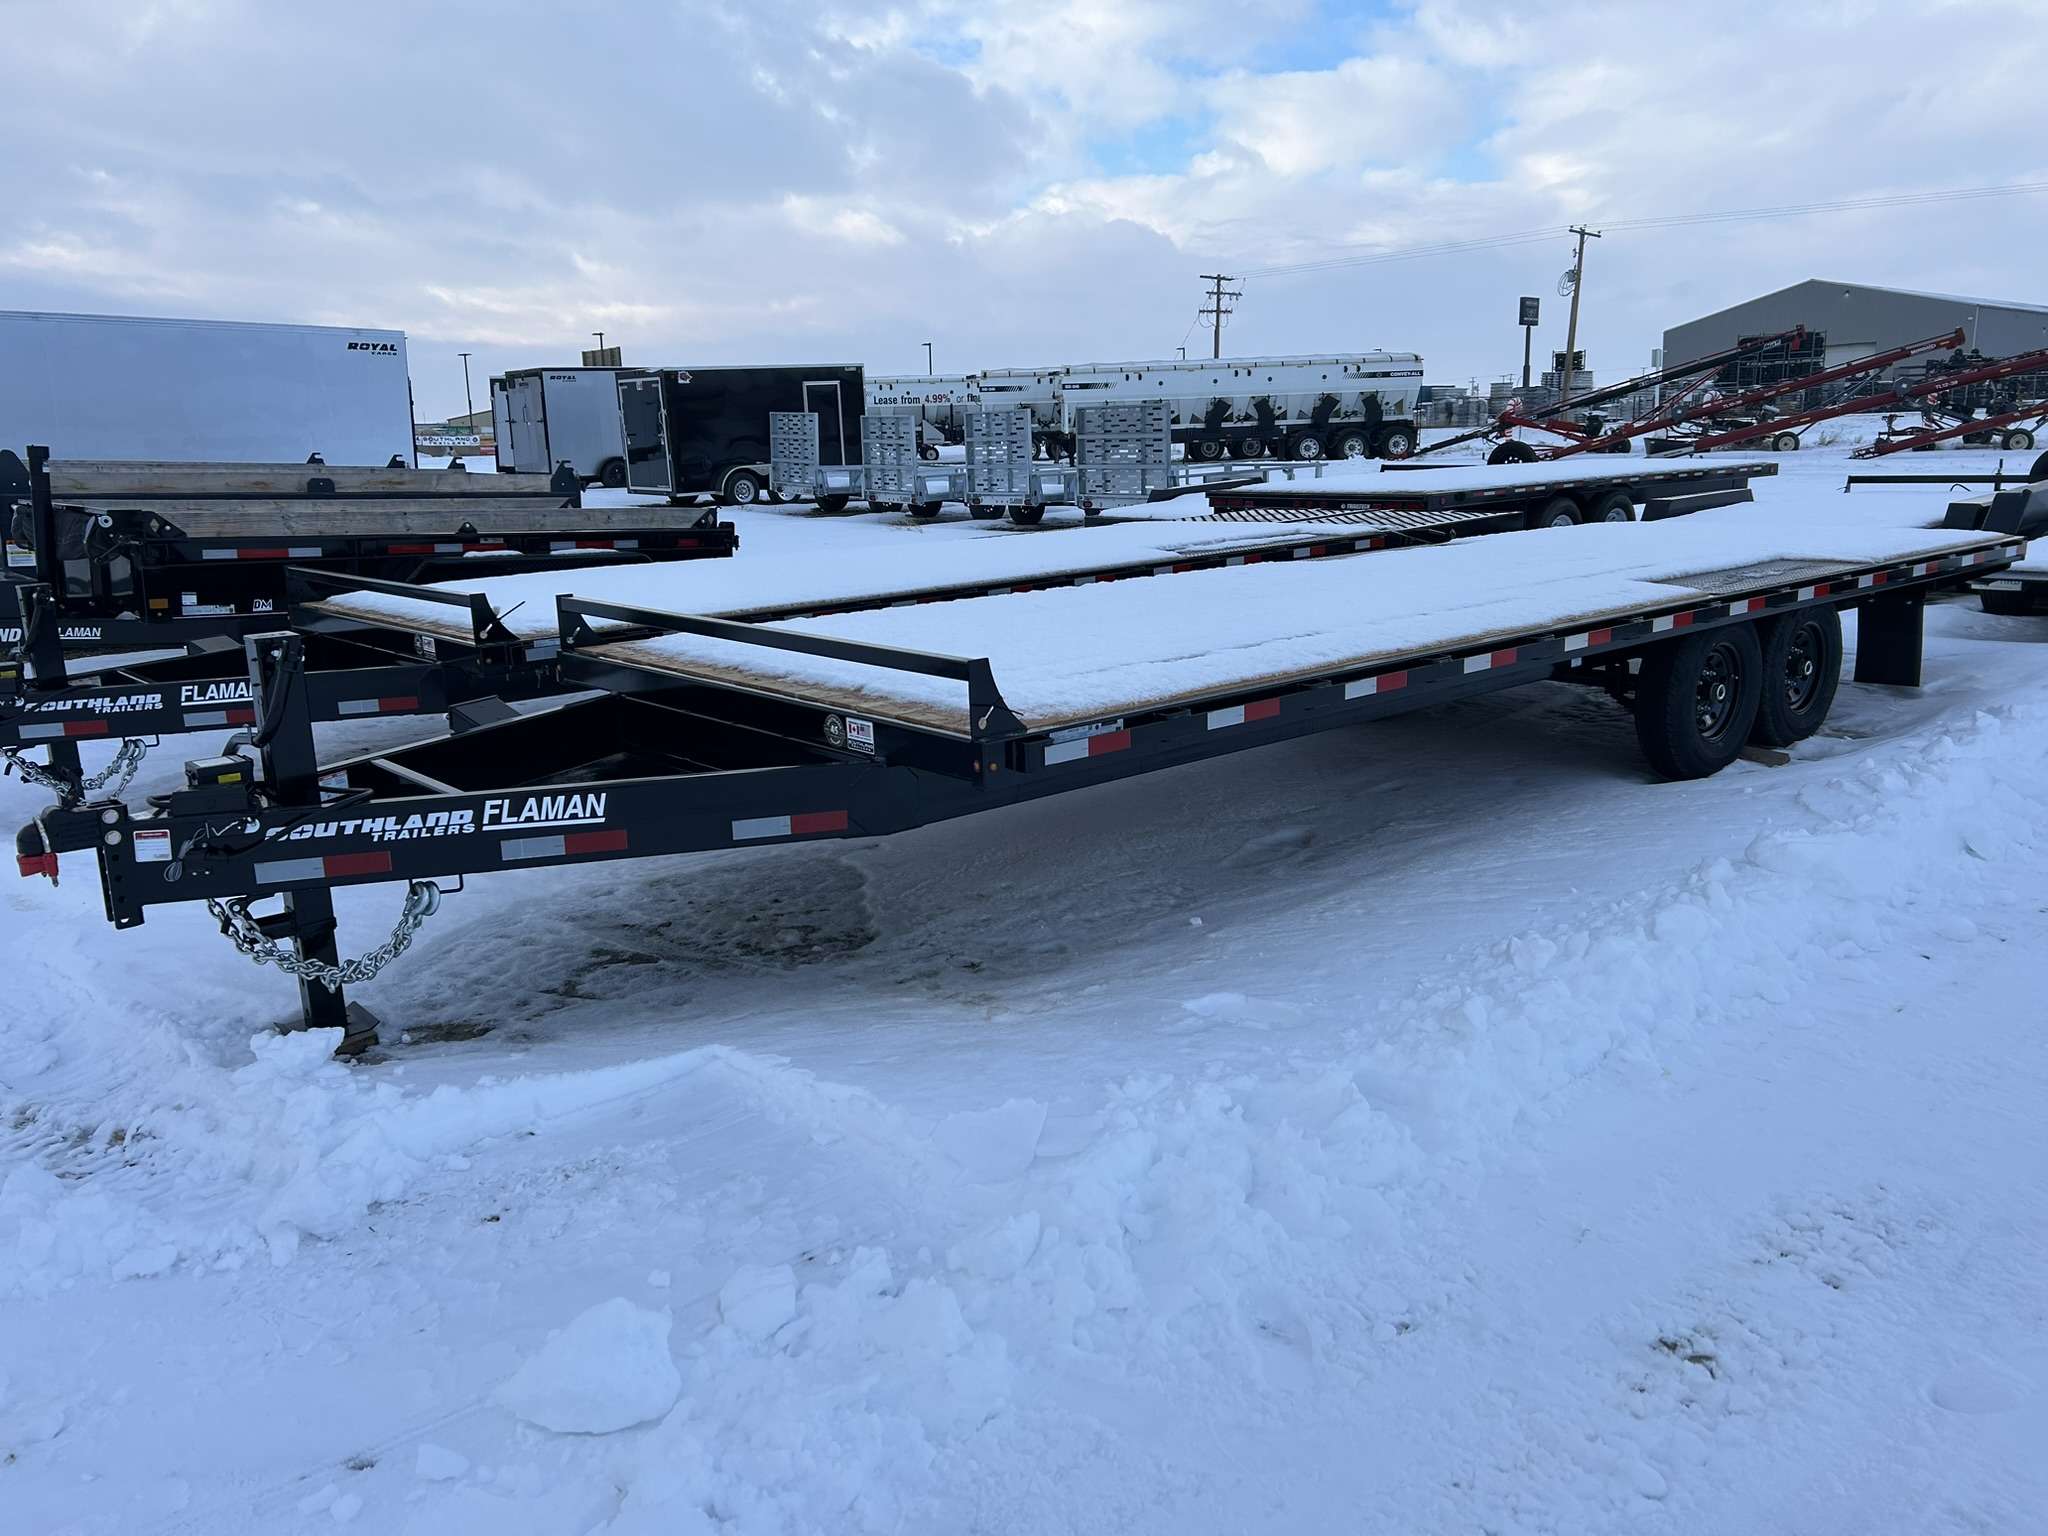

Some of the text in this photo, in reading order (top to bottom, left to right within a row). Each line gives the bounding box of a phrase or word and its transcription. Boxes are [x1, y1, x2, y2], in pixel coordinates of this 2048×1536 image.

[348, 342, 398, 351] ROYAL
[873, 395, 898, 405] Lease
[901, 395, 921, 405] from
[925, 393, 951, 404] 4.99%
[956, 395, 965, 403] or
[253, 599, 273, 612] DM
[58, 627, 102, 638] LAMAN
[181, 681, 255, 702] FLAMA
[95, 702, 164, 714] TRAILERS
[482, 792, 607, 826] FLAMAN
[371, 823, 477, 843] TRAILERS
